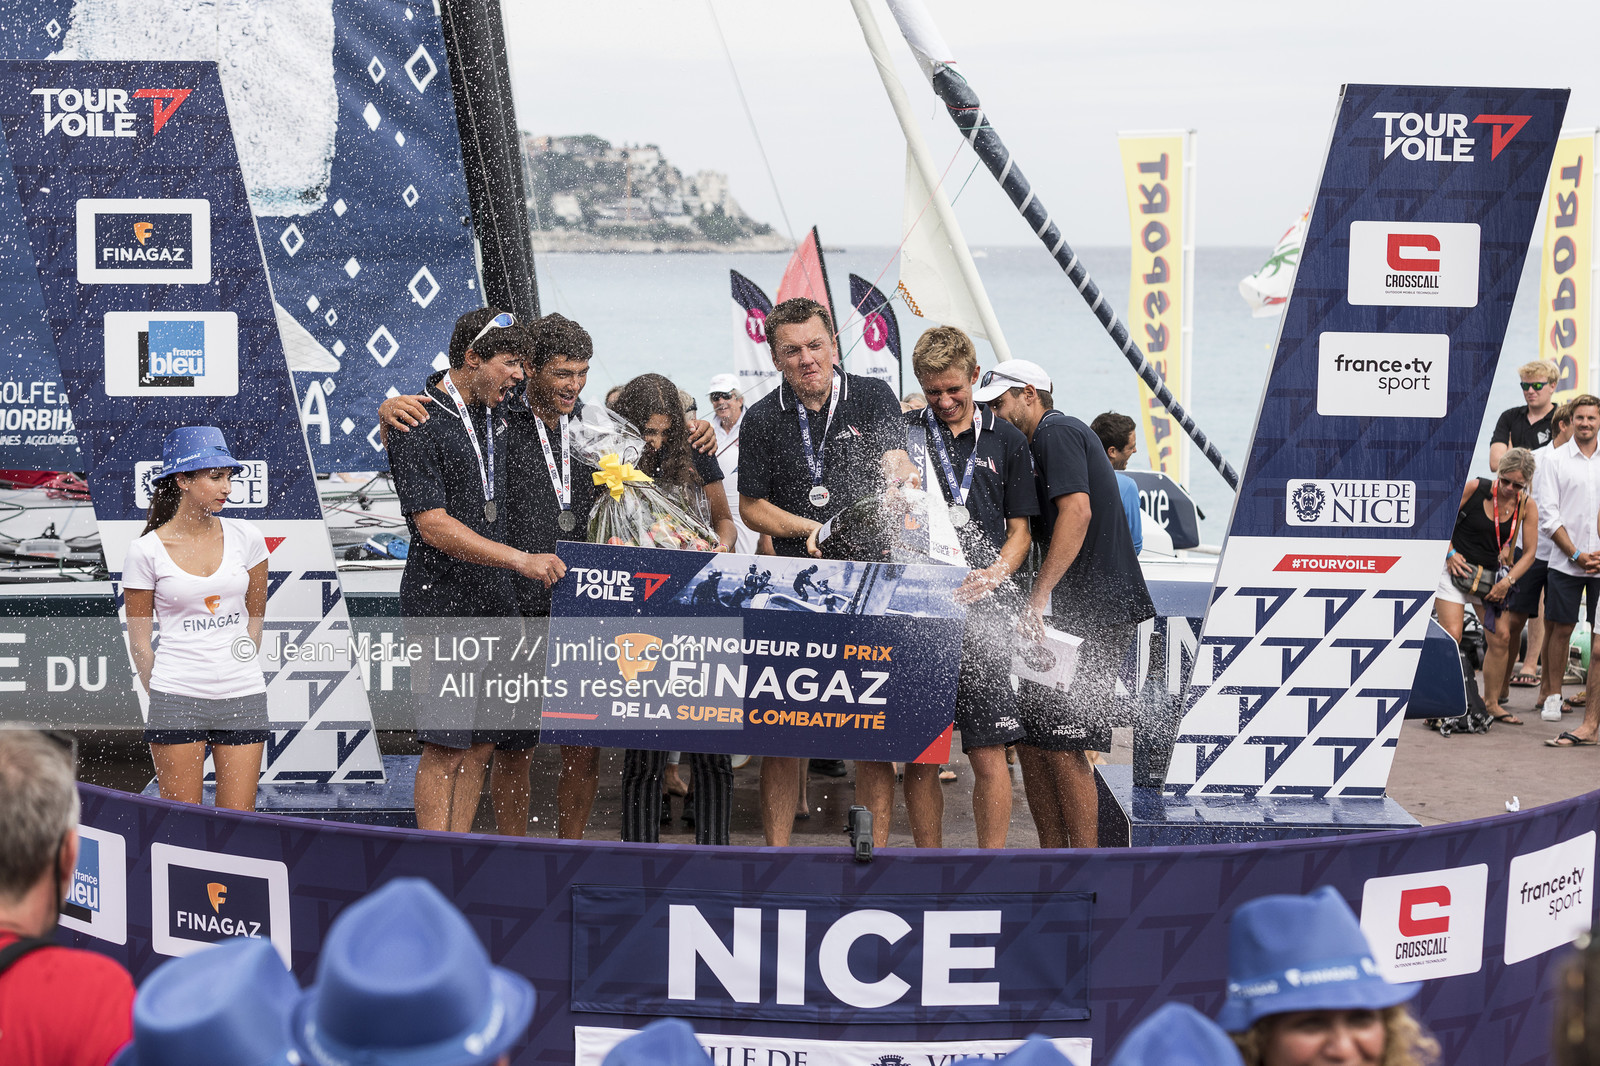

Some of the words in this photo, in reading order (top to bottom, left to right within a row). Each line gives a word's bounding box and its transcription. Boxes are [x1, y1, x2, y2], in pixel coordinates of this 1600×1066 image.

[30, 88, 129, 112] TOUR
[44, 112, 137, 137] VOILE
[1372, 112, 1468, 137] TOUR
[1384, 137, 1475, 162] VOILE
[103, 248, 184, 262] FINAGAZ
[1385, 274, 1440, 289] CROSSCALL
[150, 351, 204, 375] bleu
[172, 347, 203, 357] france
[0, 381, 57, 404] OLFE
[1378, 374, 1431, 395] sport
[1330, 482, 1380, 498] VILLE
[1386, 482, 1411, 498] DE
[1331, 500, 1410, 524] NICE
[1292, 559, 1376, 570] #TOURVOILE
[570, 568, 631, 587] TOUR
[576, 583, 635, 602] VOILE
[183, 612, 240, 632] FINAGAZ
[672, 635, 799, 657] VAINQUEUR
[805, 642, 837, 659] DU
[47, 656, 107, 692] DU
[668, 661, 890, 705] FINAGAZ
[611, 701, 641, 719] DE
[644, 703, 671, 719] LA
[676, 705, 744, 723] SUPER
[748, 708, 886, 730] COMBATIVITÉ
[75, 869, 98, 885] france
[1549, 886, 1583, 920] sport
[177, 911, 261, 939] FINAGAZ
[668, 904, 1002, 1009] NICE
[1395, 937, 1447, 960] CROSSCALL
